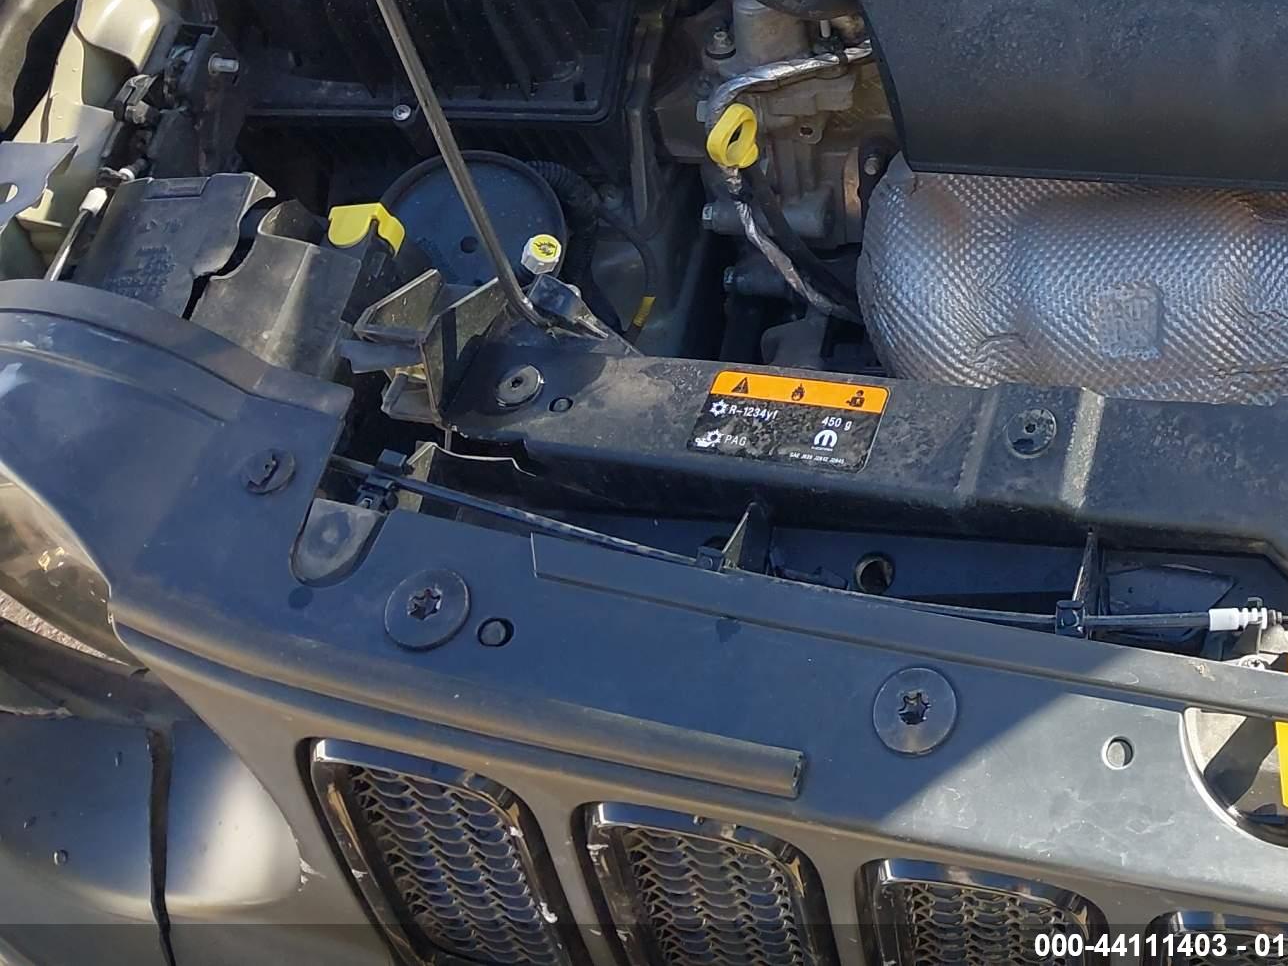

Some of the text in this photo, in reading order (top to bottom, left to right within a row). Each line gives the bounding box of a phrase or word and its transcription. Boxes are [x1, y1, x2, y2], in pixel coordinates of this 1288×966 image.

[729, 405, 778, 421] R-1234yf
[822, 416, 853, 431] 450 g
[724, 434, 748, 446] PAG
